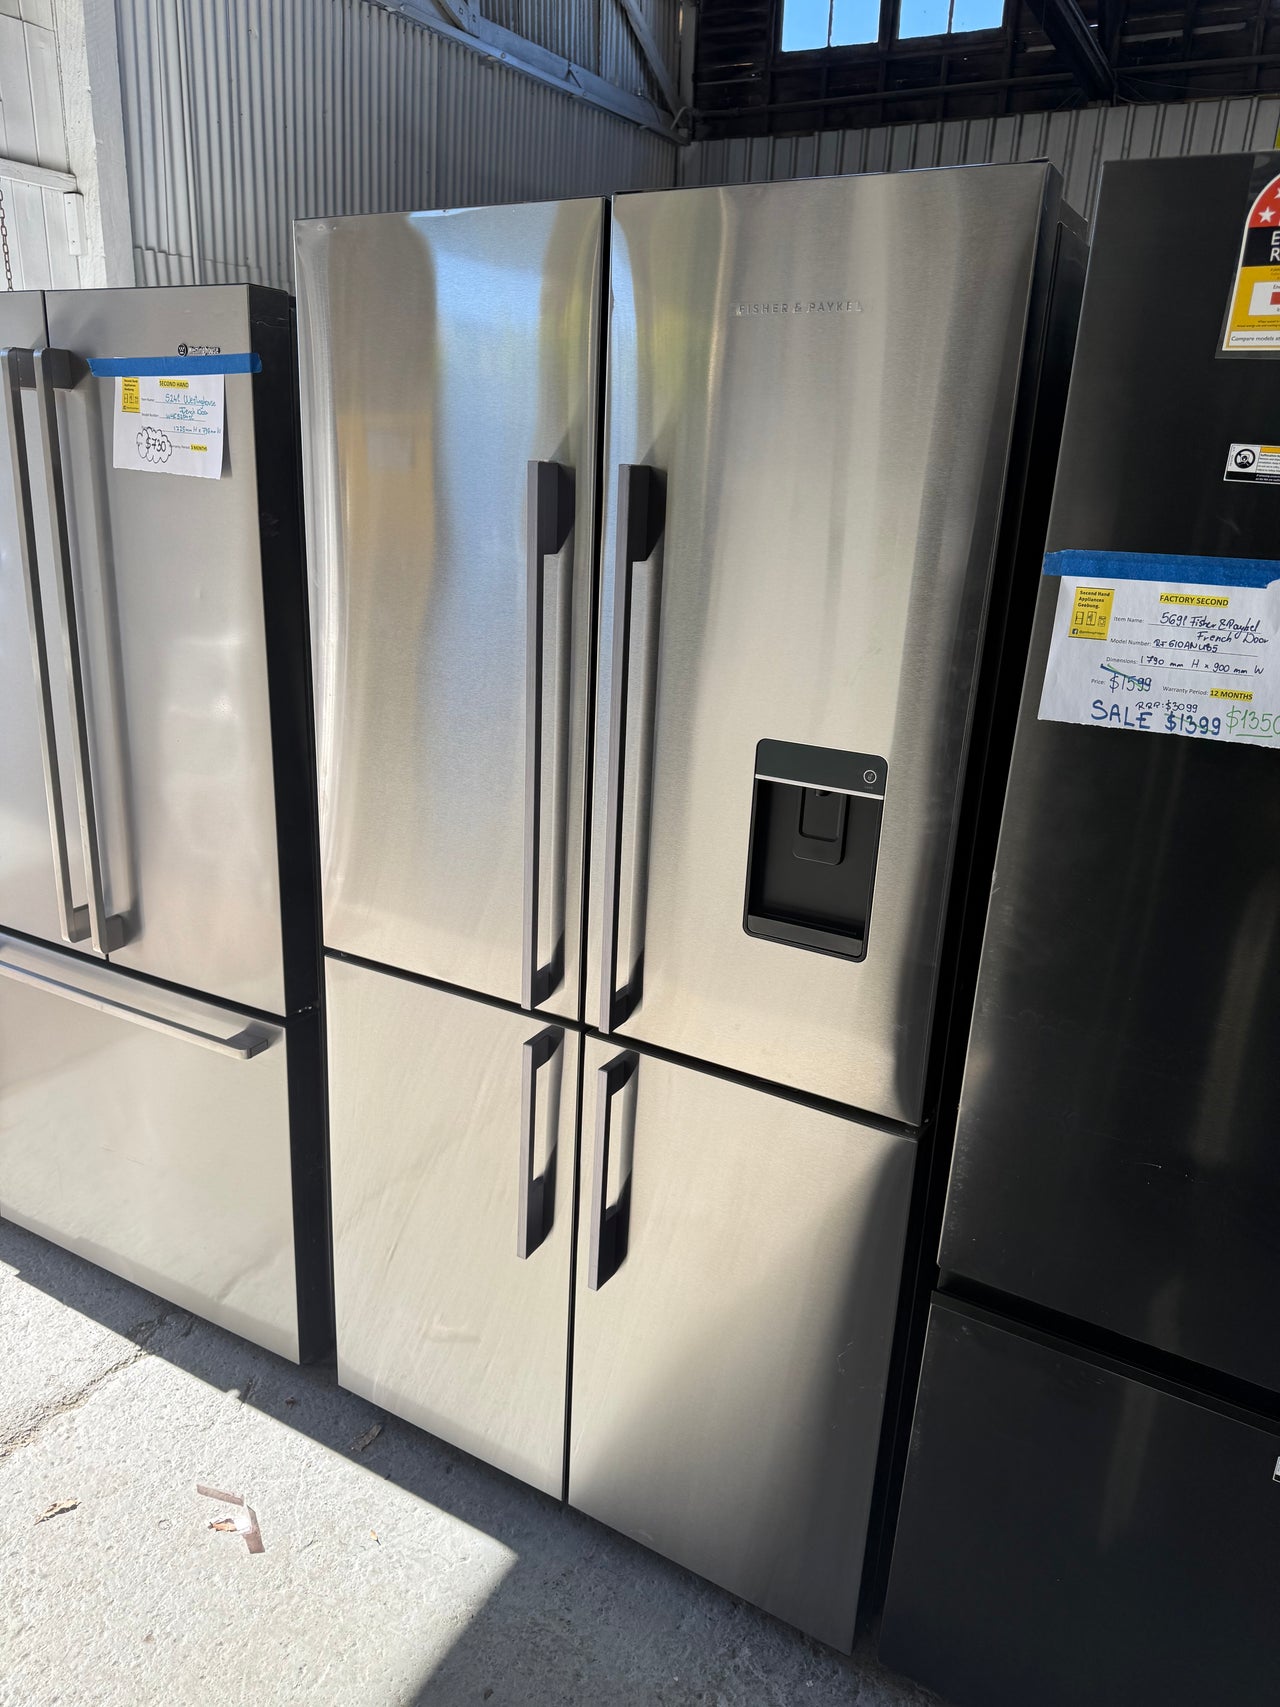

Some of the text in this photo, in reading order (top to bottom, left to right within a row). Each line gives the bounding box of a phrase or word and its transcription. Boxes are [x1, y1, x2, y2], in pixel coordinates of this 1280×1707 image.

[737, 301, 864, 315] FISHER & PAYKEL
[1159, 594, 1229, 606] FACTORY SECOND
[1197, 630, 1269, 644] French Door
[1106, 656, 1138, 664] Dimensions:
[1191, 658, 1200, 669] H
[1212, 662, 1230, 673] 900
[1254, 665, 1265, 675] W
[1162, 686, 1188, 694] Warranty
[1210, 689, 1219, 697] 12
[1219, 690, 1253, 700] MONTHS
[1091, 699, 1153, 729] SALE
[1164, 710, 1221, 736] $1399
